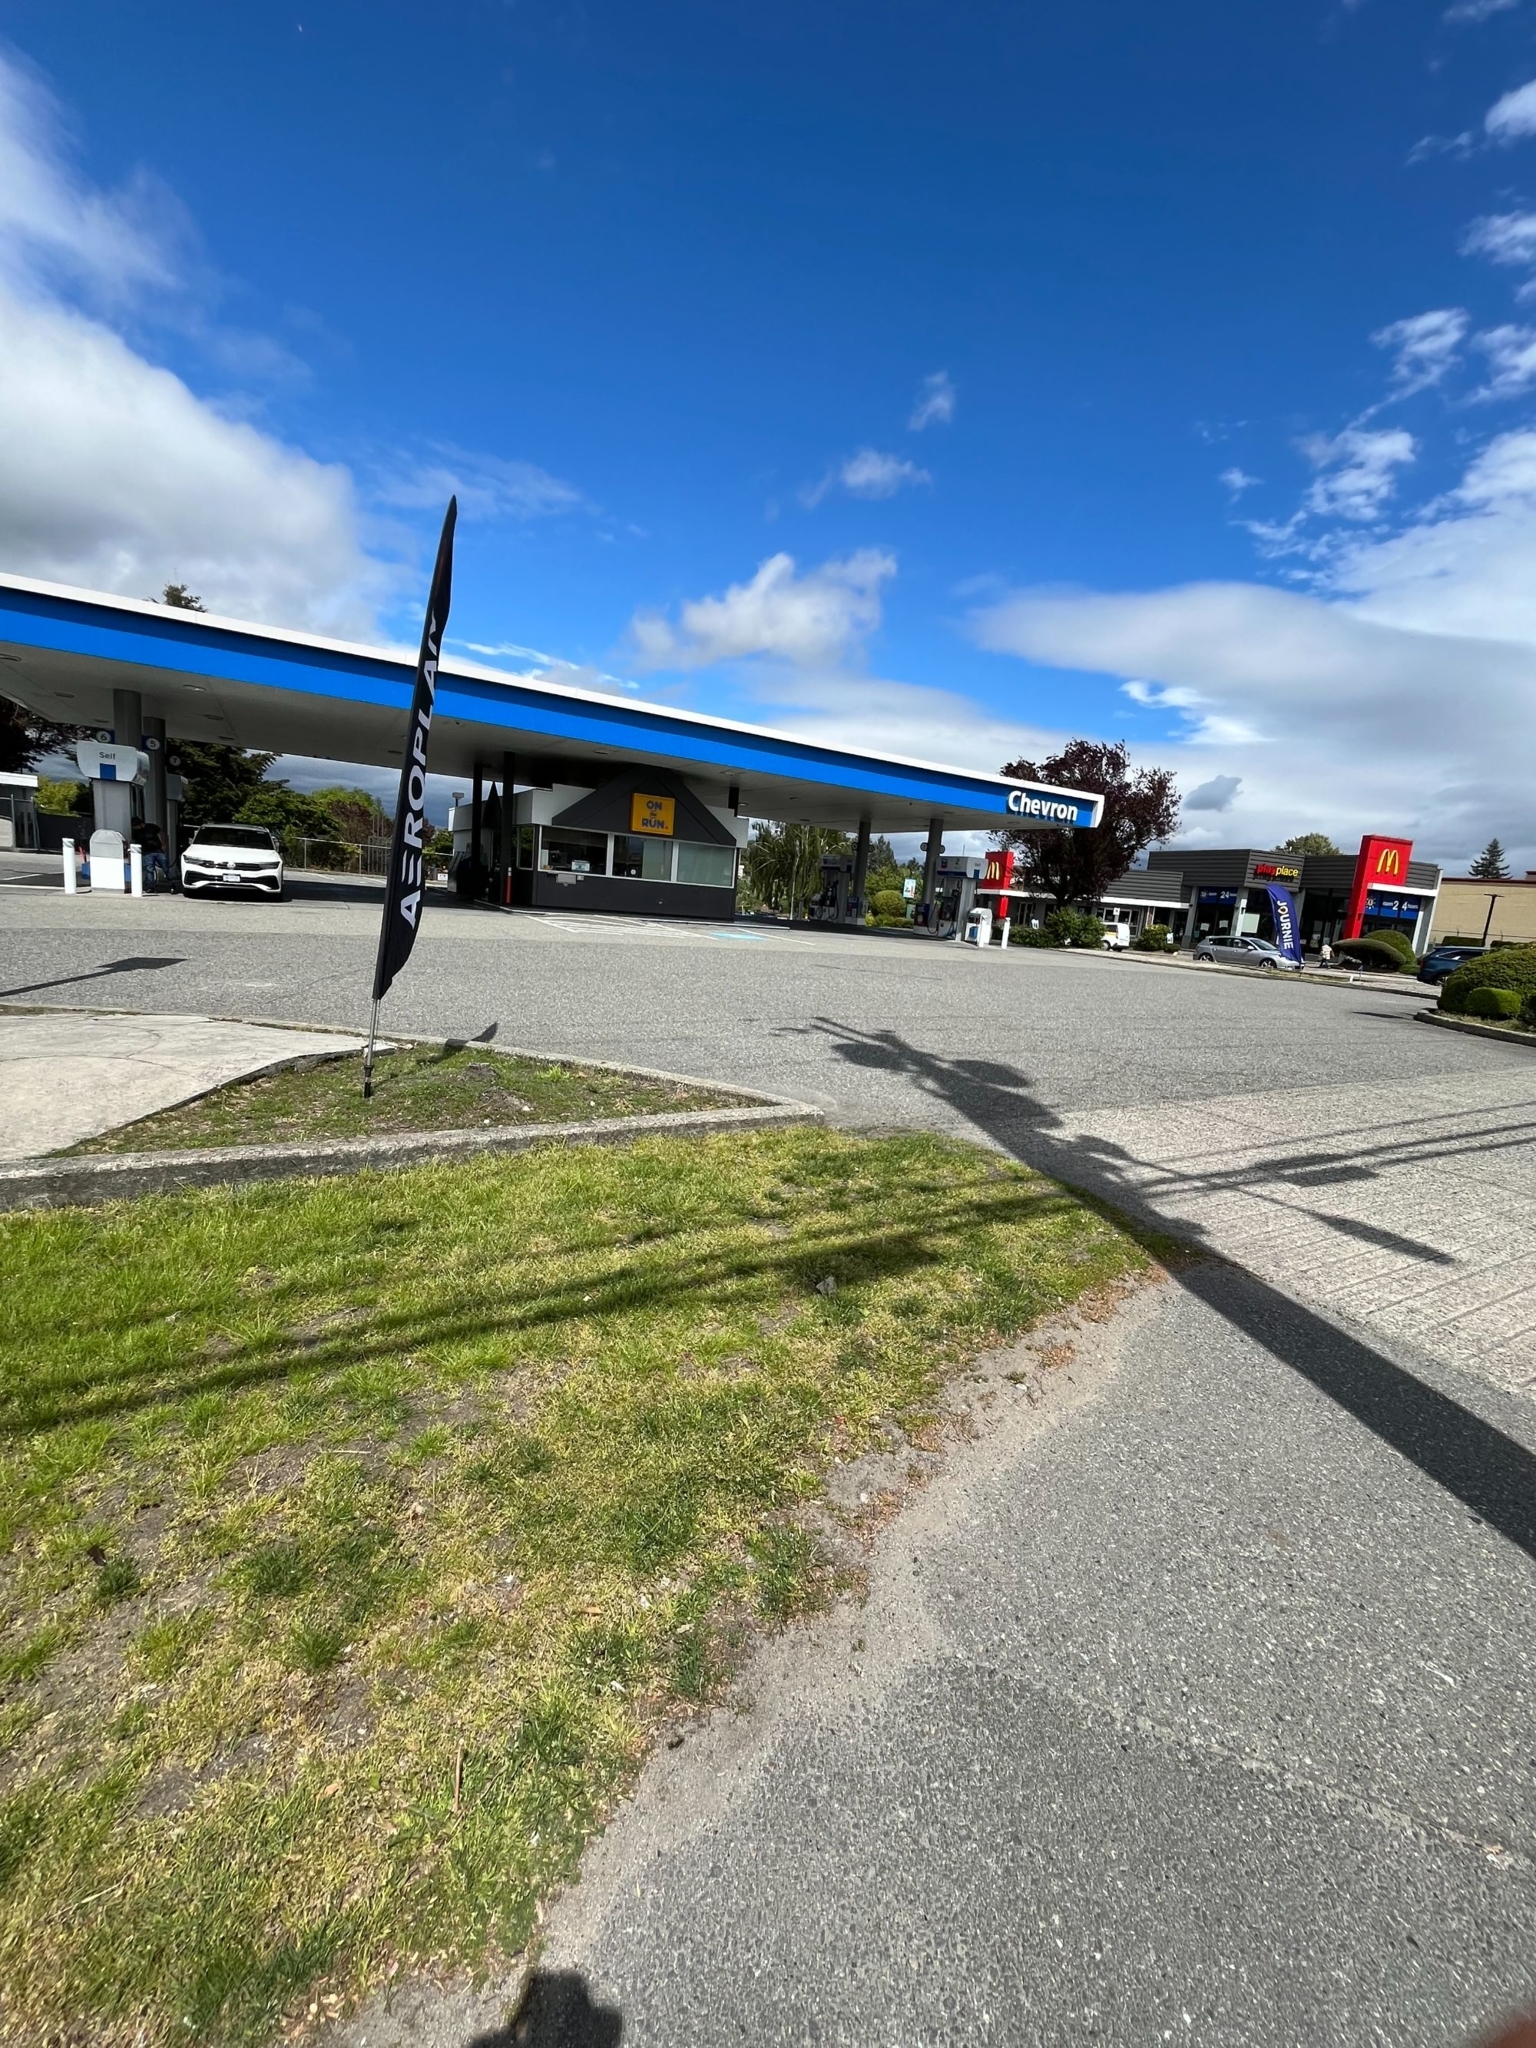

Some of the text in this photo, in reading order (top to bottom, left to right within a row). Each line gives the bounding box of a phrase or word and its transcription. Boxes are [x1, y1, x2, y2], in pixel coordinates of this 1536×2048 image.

[101, 733, 107, 741] 6
[149, 740, 156, 748] 5
[99, 751, 116, 760] Self
[646, 801, 663, 811] ON
[1008, 791, 1078, 821] Chevron
[1220, 890, 1230, 899] 24
[1277, 900, 1294, 949] JOURNIE
